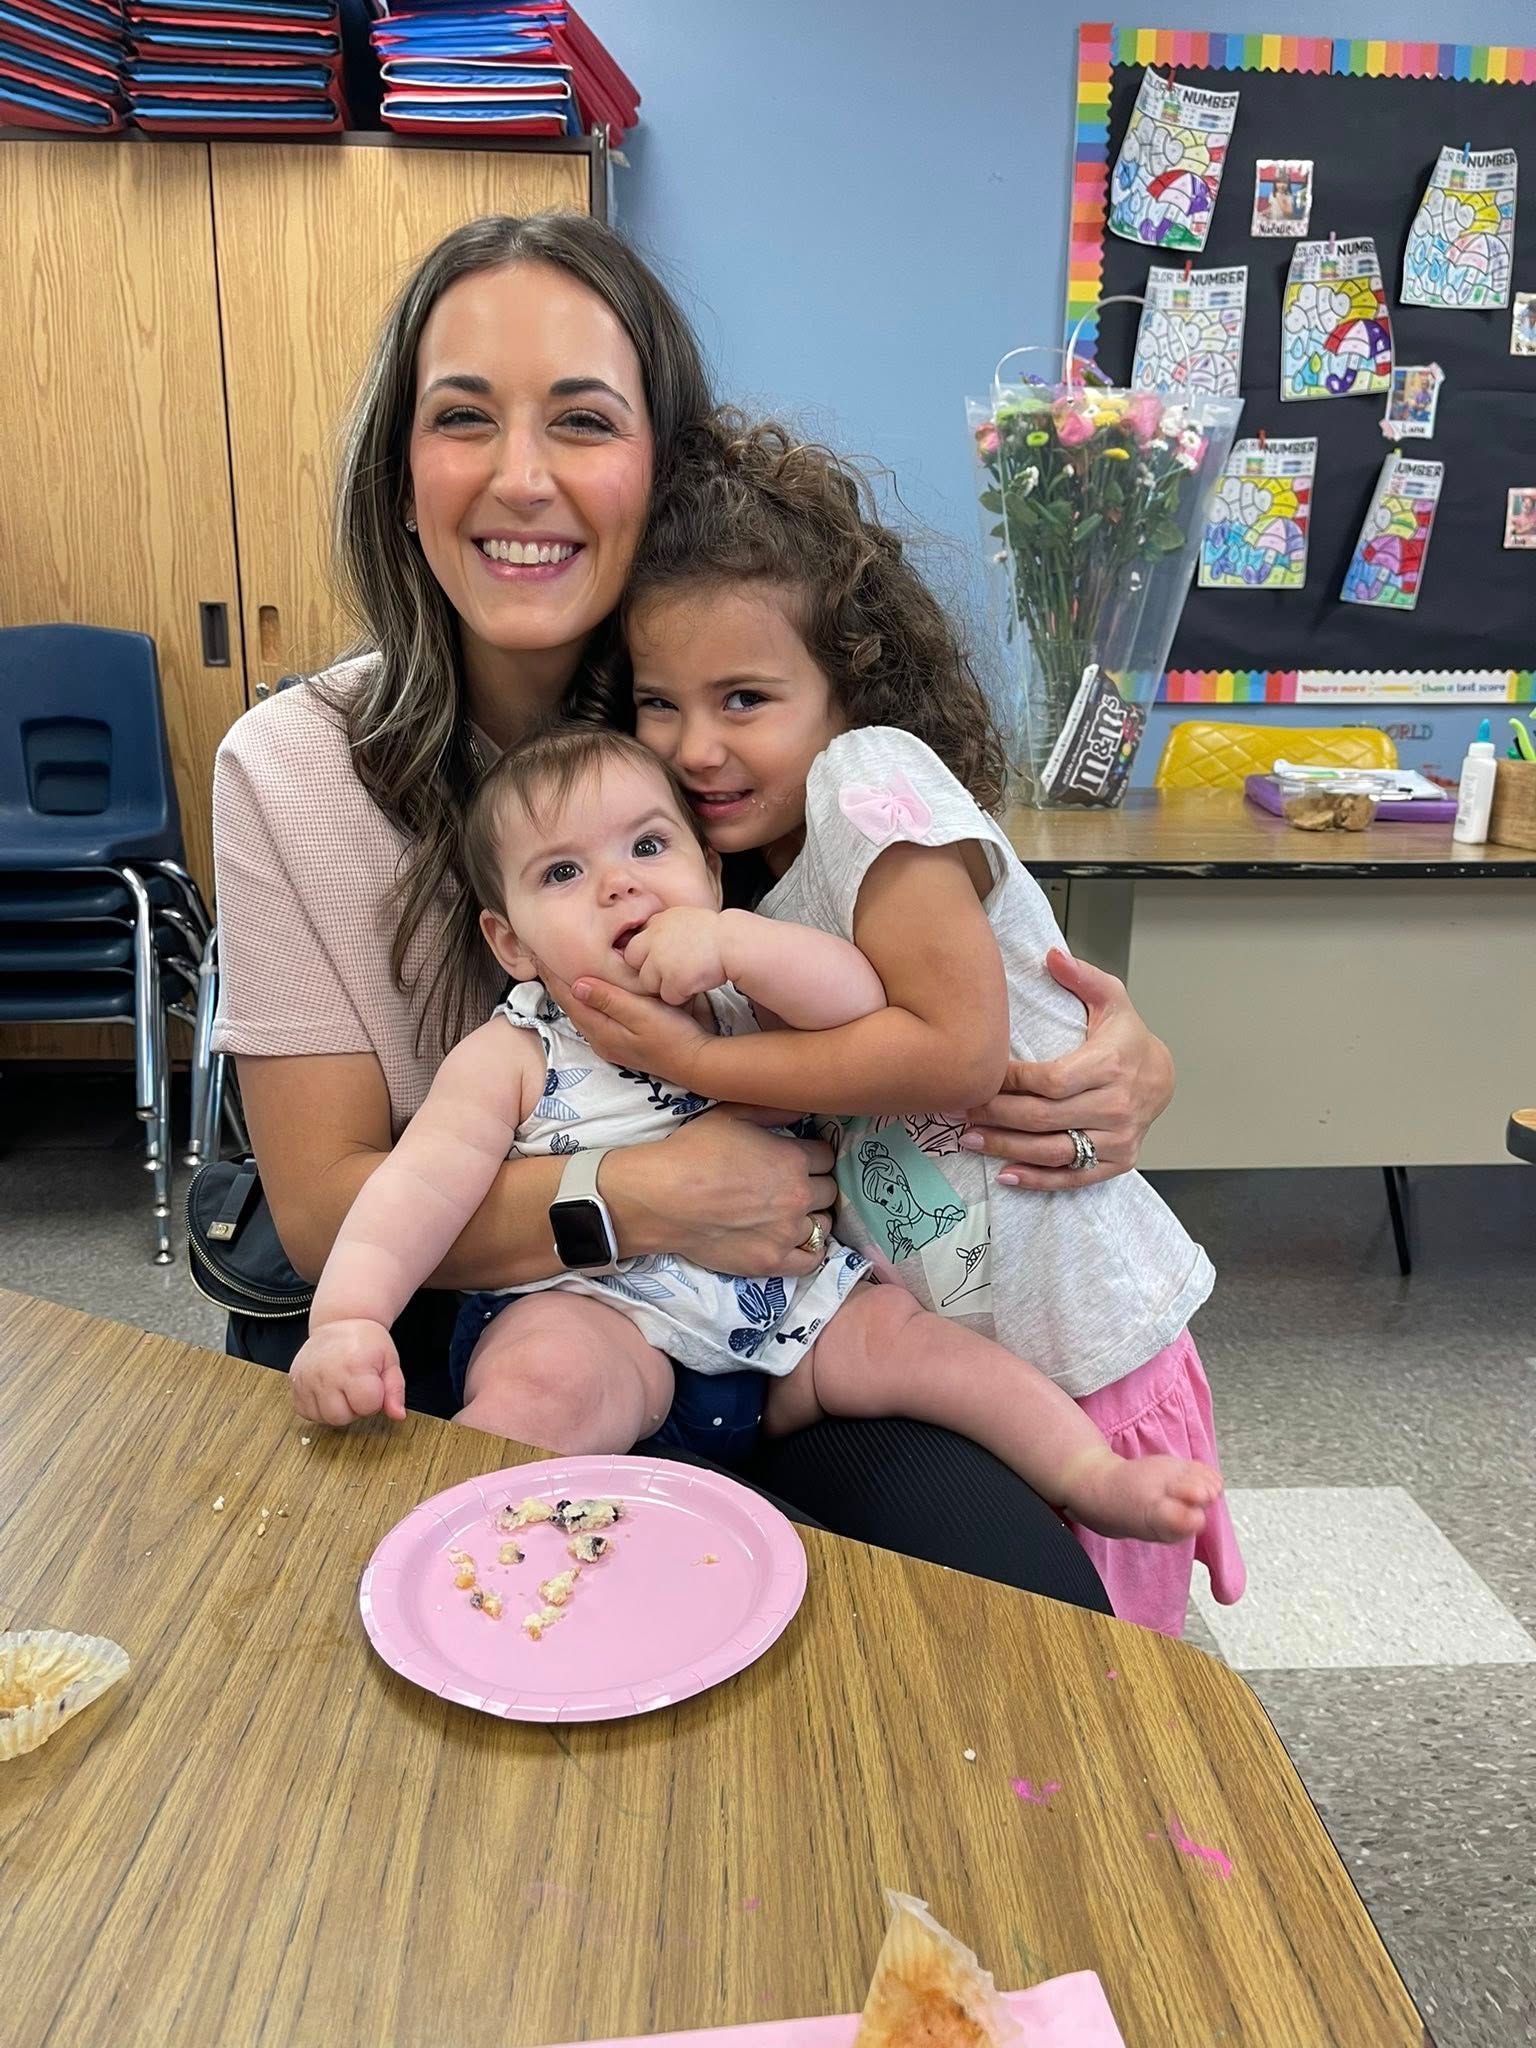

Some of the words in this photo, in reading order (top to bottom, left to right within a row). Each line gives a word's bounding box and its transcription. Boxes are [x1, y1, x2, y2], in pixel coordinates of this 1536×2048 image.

[1182, 90, 1237, 109] NUMBER
[1467, 152, 1516, 168] NUMBER
[1337, 241, 1375, 256] NUMBE
[1190, 270, 1244, 287] NUMBER
[1264, 442, 1315, 454] NUMBER
[1395, 463, 1441, 477] UMBER
[1383, 724, 1433, 740] ORLD
